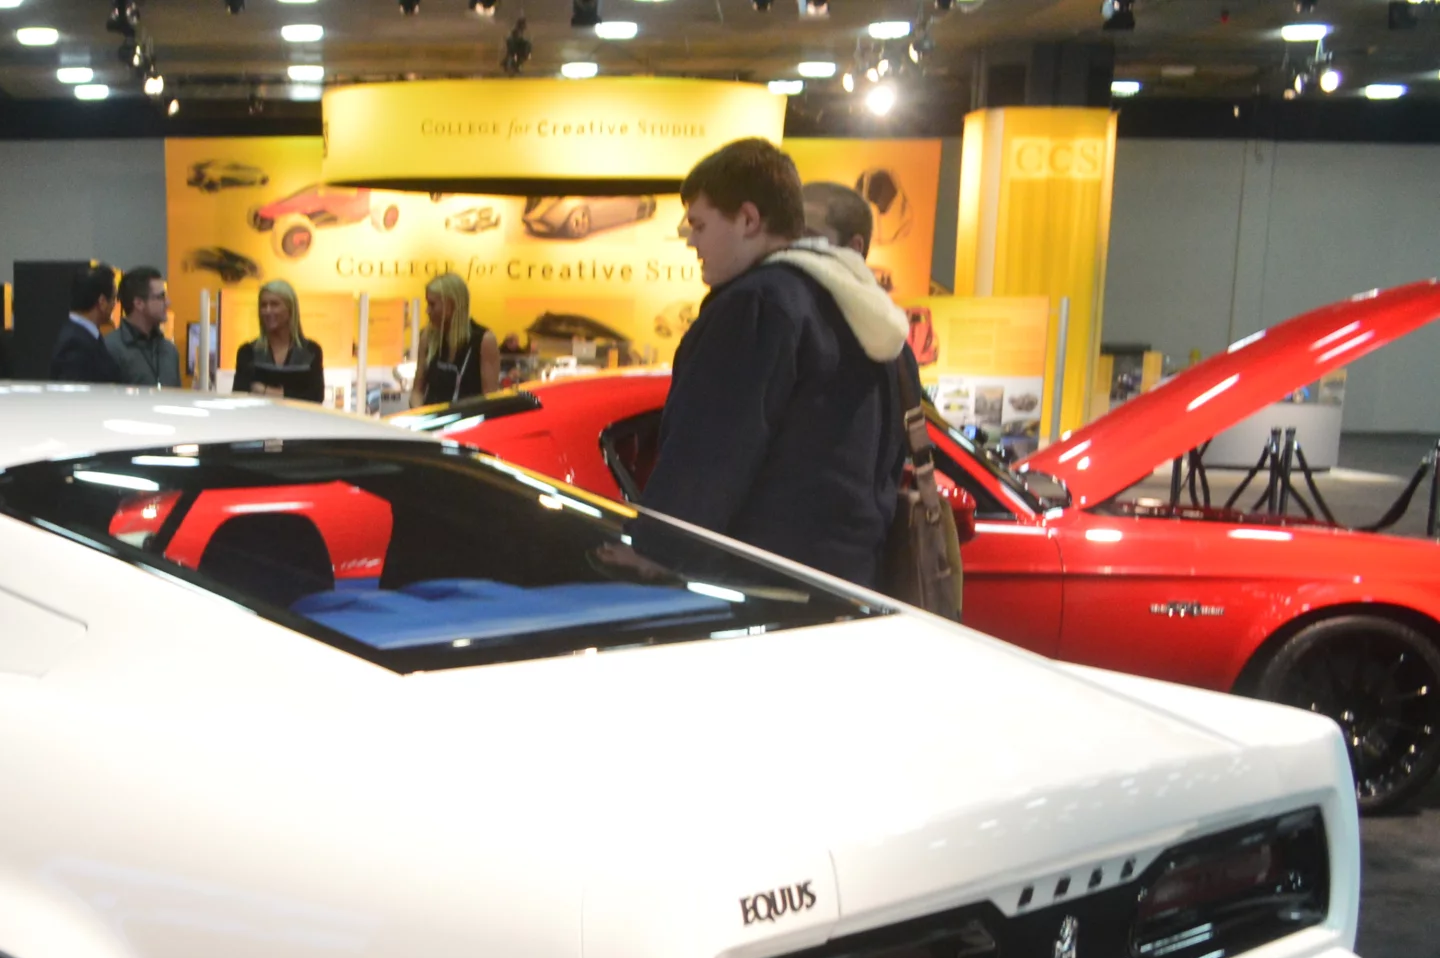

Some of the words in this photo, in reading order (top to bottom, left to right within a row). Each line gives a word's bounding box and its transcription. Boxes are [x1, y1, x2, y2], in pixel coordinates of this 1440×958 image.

[508, 118, 532, 139] for
[537, 119, 629, 137] Creative
[1015, 143, 1099, 174] CCS
[467, 255, 498, 281] for
[506, 257, 634, 282] Creative
[645, 258, 696, 283] STU
[738, 879, 817, 926] EQUUS
